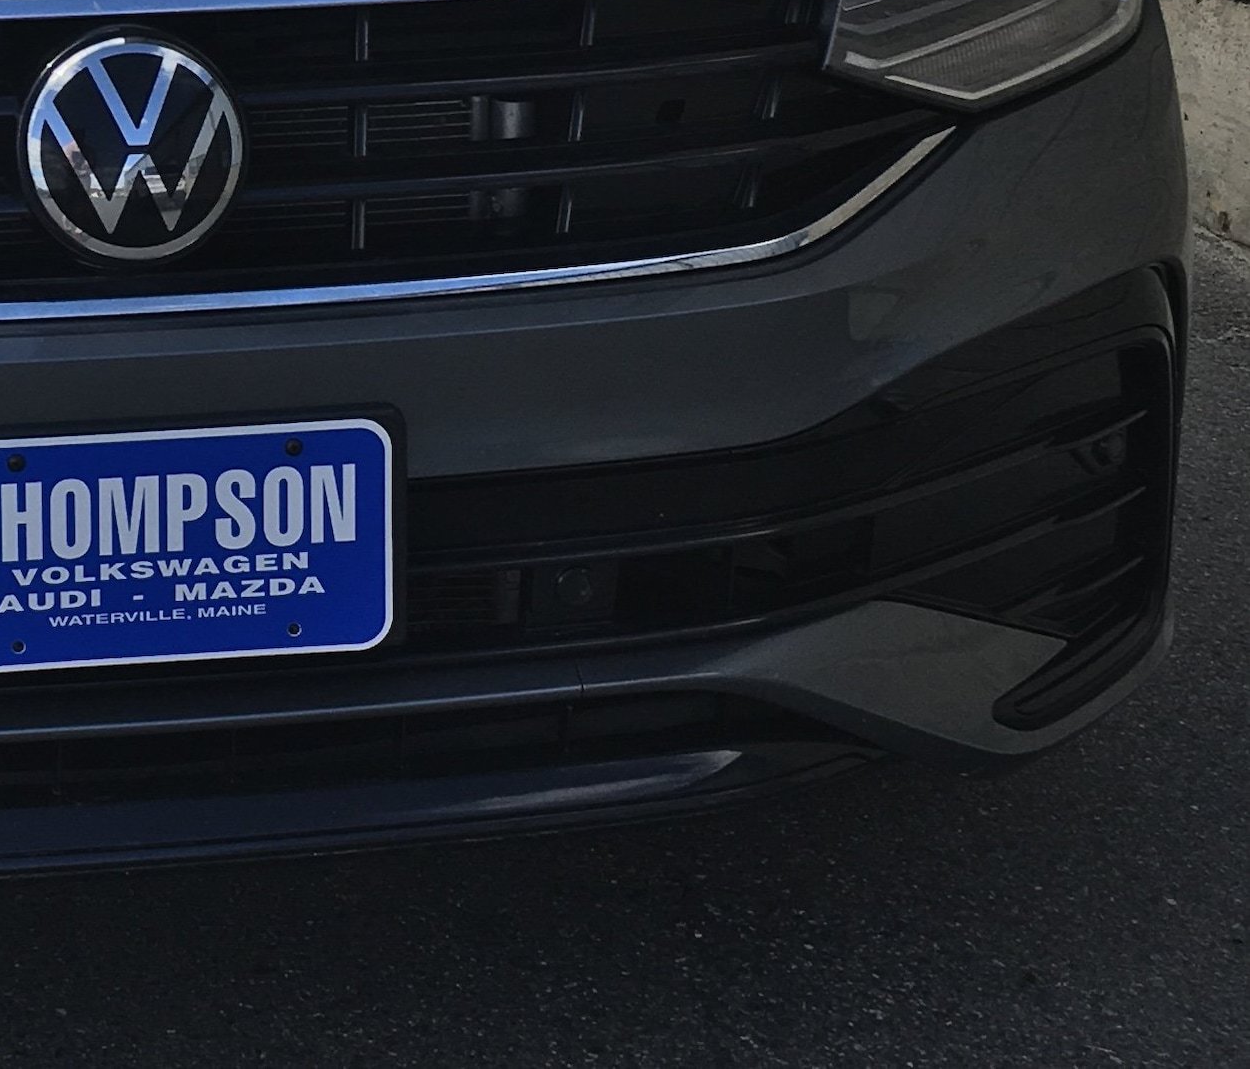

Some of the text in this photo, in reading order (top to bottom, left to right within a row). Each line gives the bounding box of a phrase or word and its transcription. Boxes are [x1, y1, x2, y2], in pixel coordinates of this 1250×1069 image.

[11, 551, 310, 587] VOLKSWAGEN
[174, 576, 327, 602] MAZDA
[197, 603, 267, 618] MAINE
